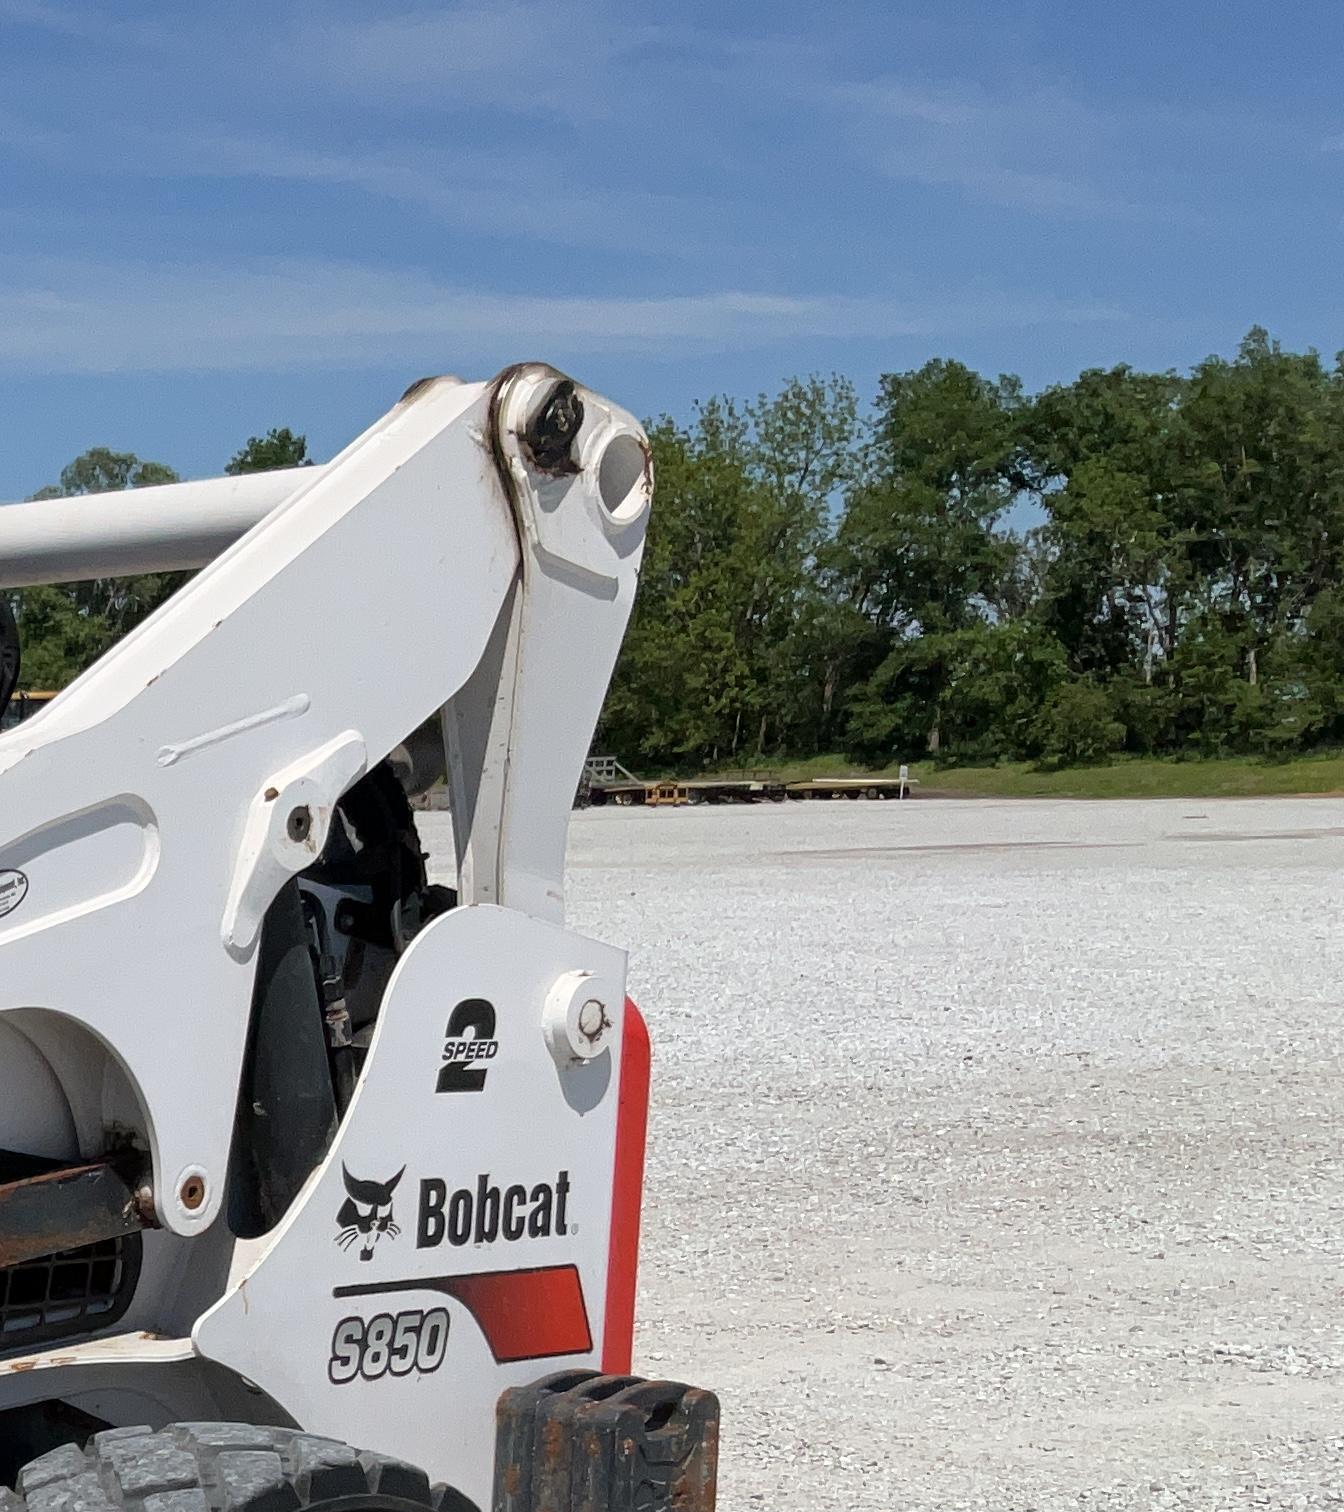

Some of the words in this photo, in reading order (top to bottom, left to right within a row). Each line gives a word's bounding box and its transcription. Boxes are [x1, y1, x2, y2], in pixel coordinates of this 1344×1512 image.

[435, 998, 496, 1093] 2
[441, 1040, 499, 1061] SPEED
[416, 1170, 570, 1249] Bobcat
[328, 1307, 450, 1385] S850
